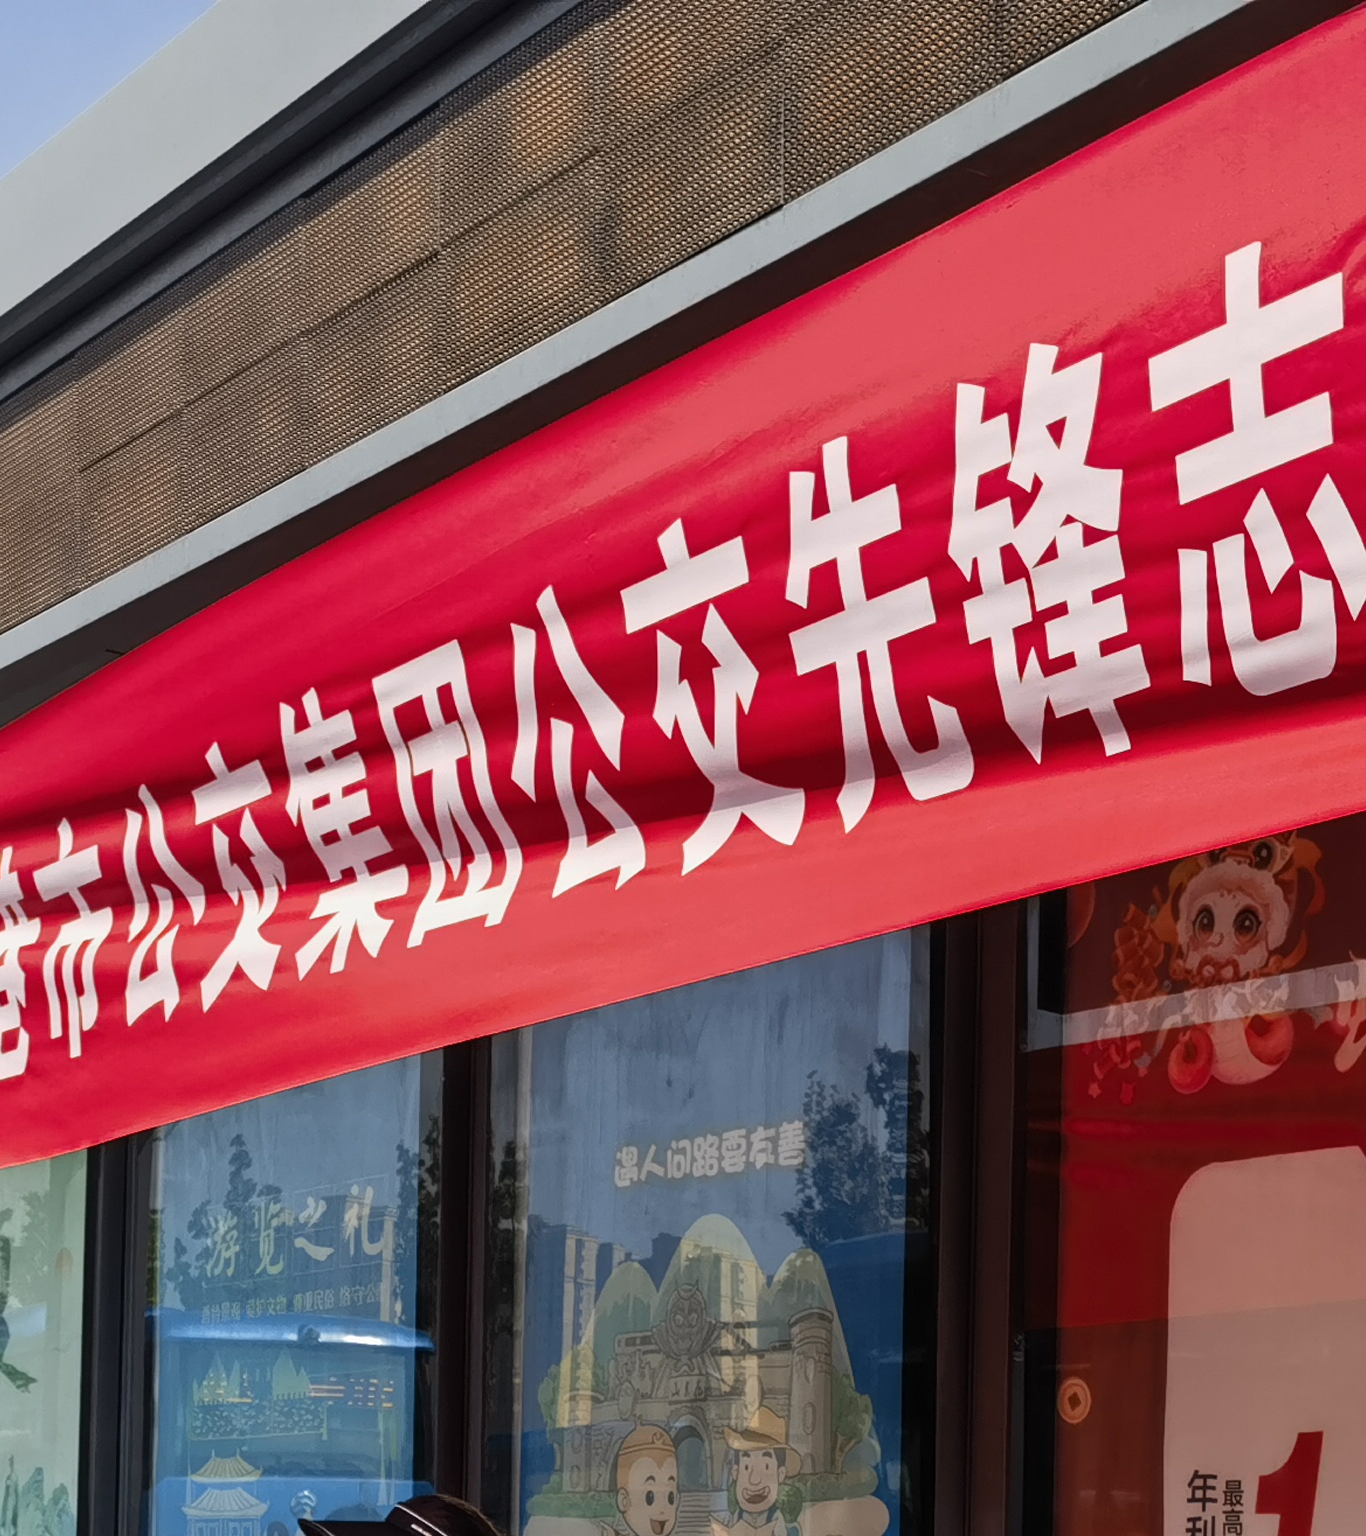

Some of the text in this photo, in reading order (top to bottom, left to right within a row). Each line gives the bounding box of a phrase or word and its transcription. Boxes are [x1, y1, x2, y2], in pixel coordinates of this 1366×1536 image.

[614, 1119, 806, 1188] 遇人问路要友善
[205, 1184, 384, 1278] 游览之礼
